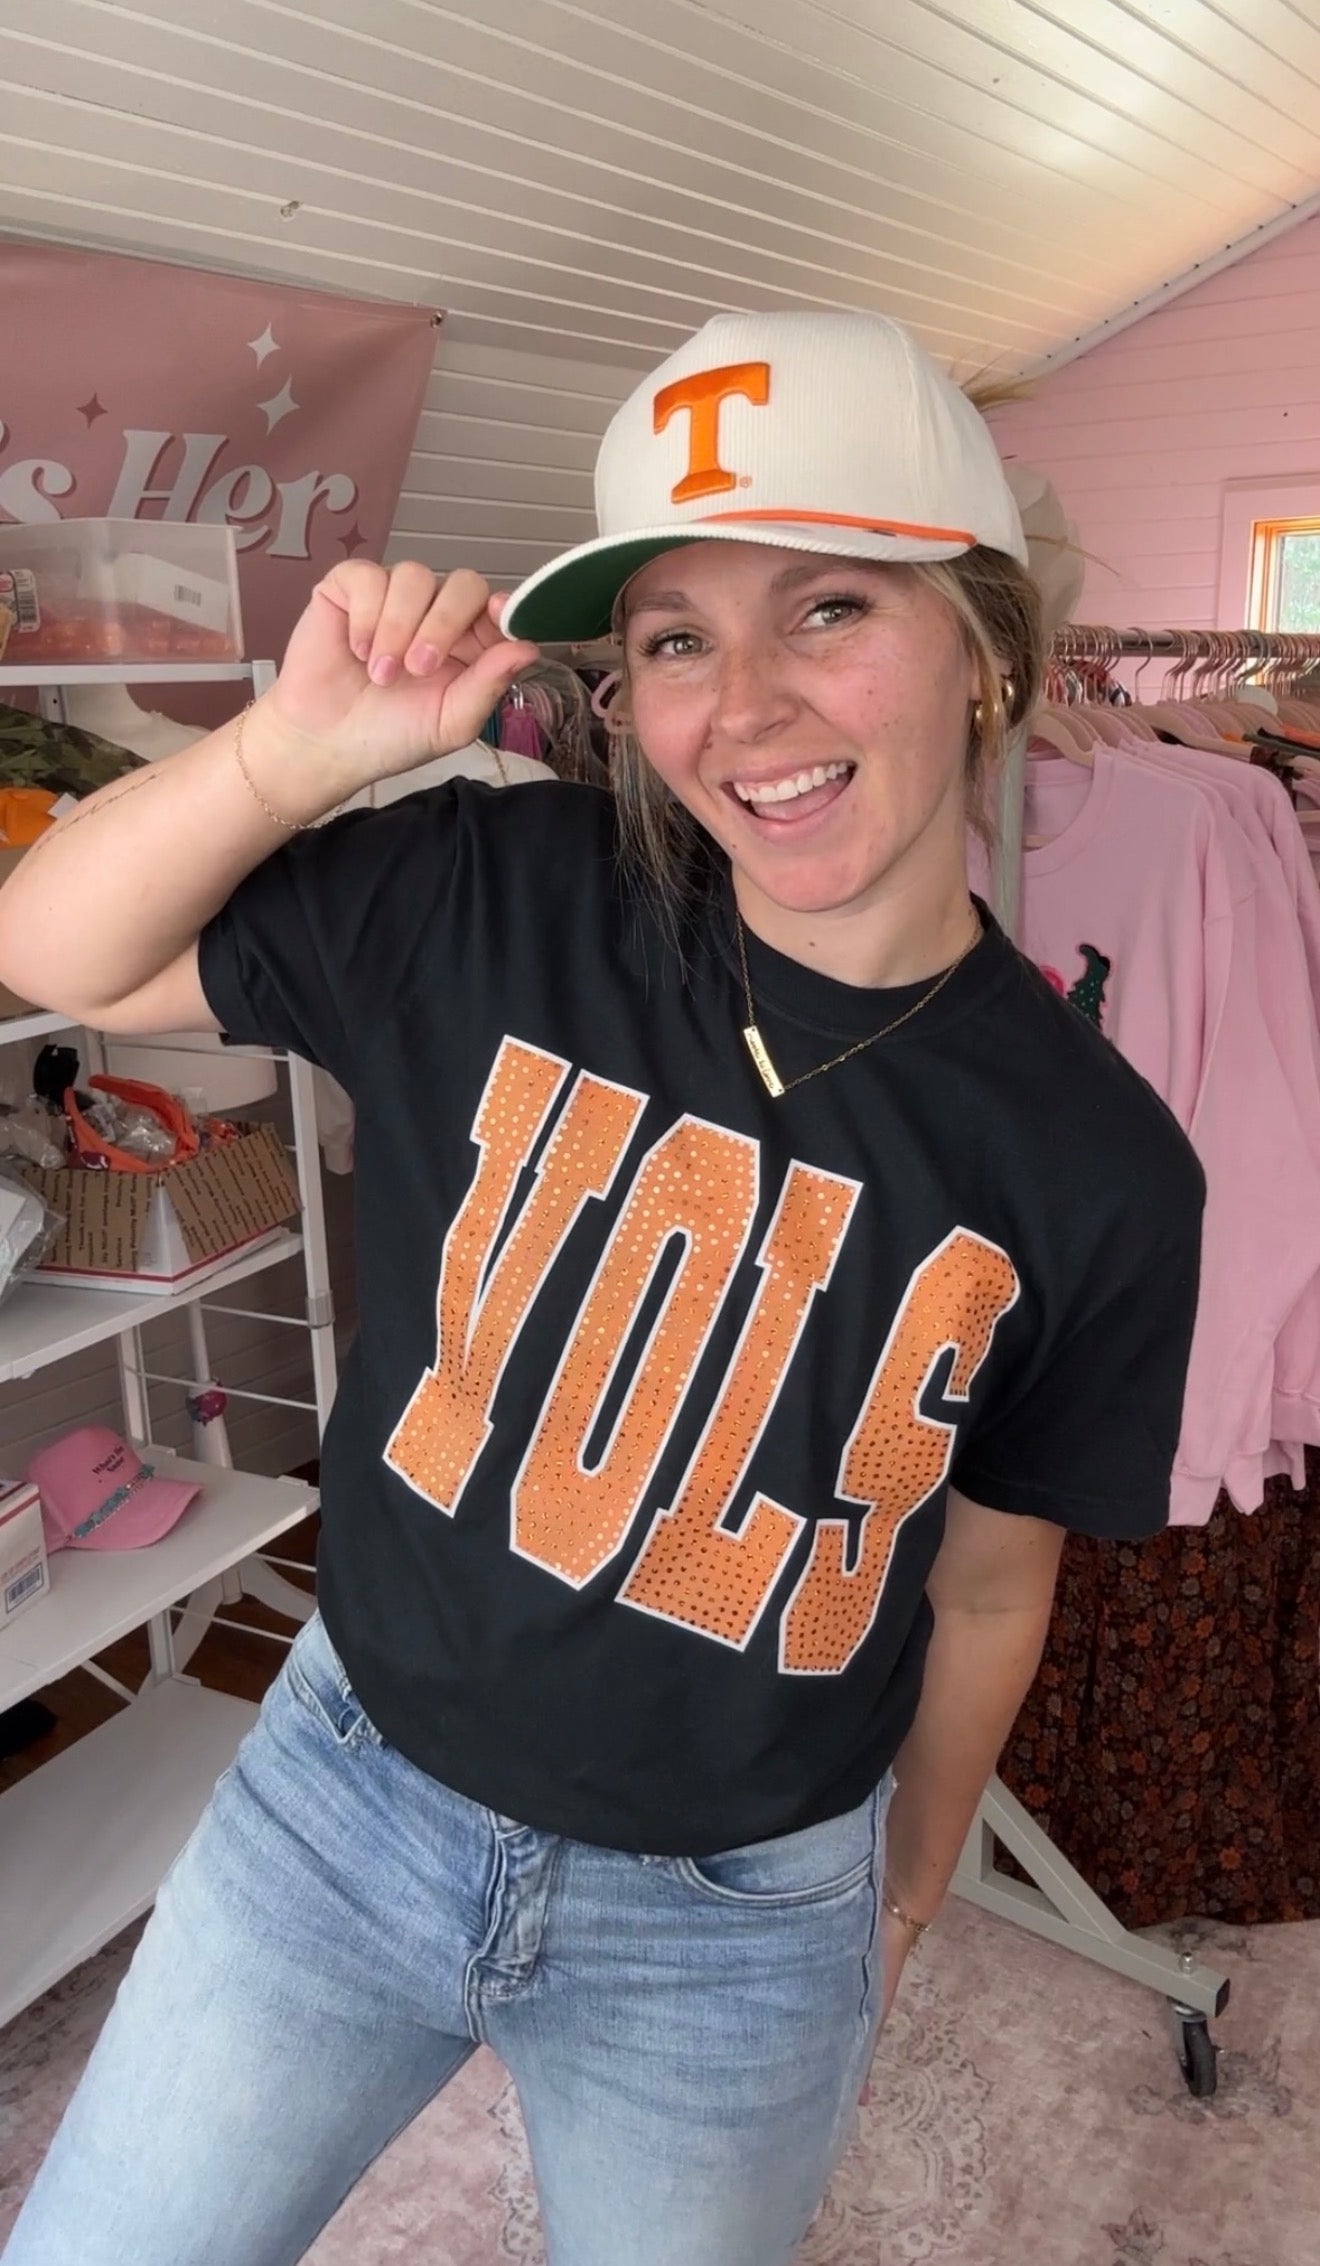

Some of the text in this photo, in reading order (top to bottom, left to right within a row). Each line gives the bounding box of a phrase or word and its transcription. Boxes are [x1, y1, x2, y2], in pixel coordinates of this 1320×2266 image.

[106, 430, 358, 559] Her
[653, 361, 771, 505] T
[383, 1034, 1021, 1675] VOLS
